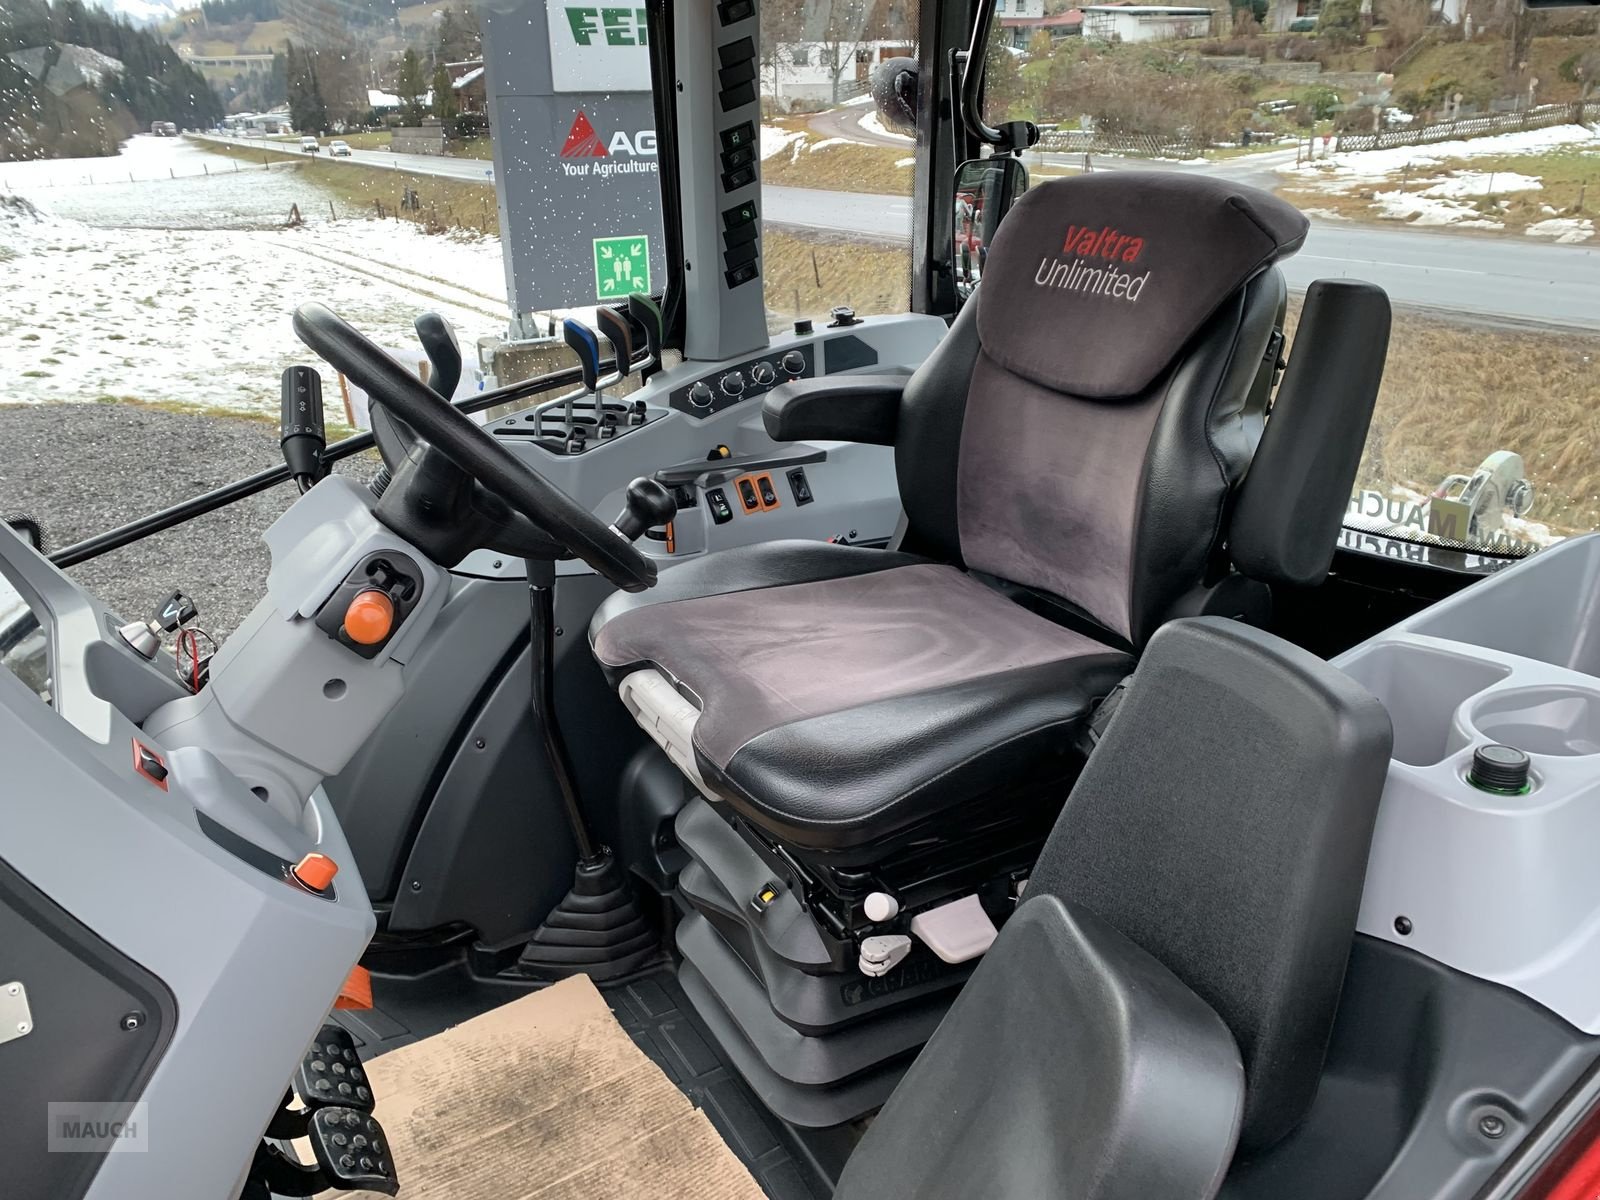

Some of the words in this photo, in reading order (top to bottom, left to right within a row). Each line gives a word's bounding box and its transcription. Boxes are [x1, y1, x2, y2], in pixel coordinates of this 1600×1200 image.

[562, 162, 590, 176] Your
[592, 159, 658, 177] Agriculture
[1063, 225, 1144, 262] Valtra
[1034, 257, 1150, 302] Unlimited
